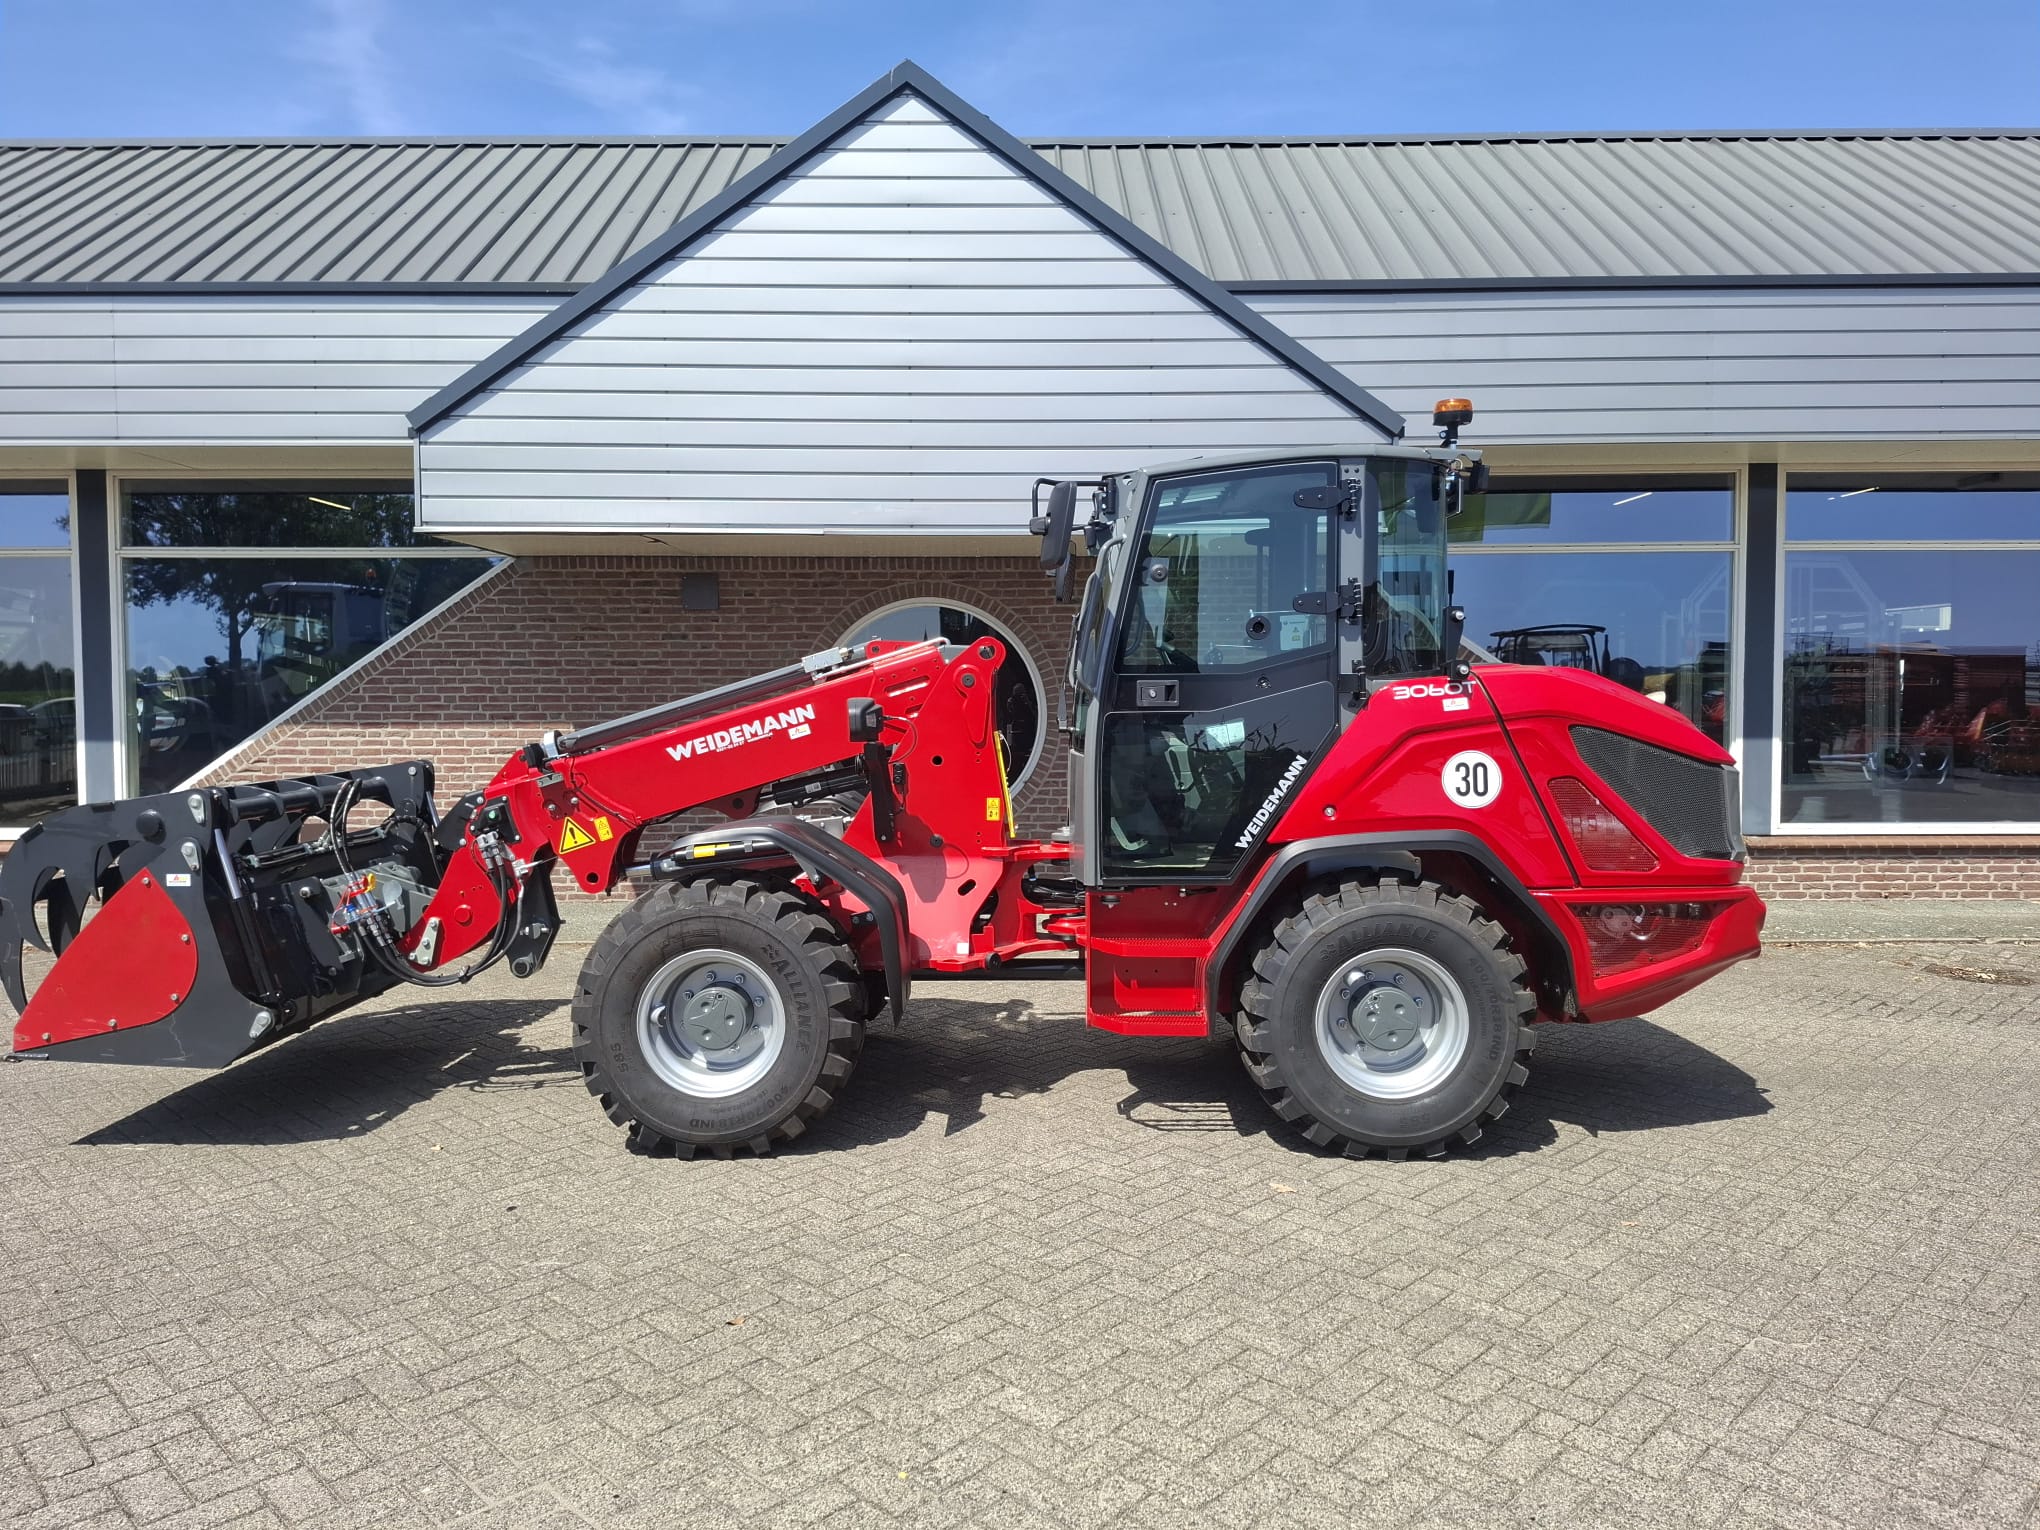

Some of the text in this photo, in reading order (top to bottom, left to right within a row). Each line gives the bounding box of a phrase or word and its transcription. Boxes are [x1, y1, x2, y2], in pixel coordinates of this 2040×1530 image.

[665, 703, 816, 761] WEIDEMANN
[1234, 754, 1308, 848] WEIDEMANN
[1455, 762, 1489, 797] 30
[1337, 921, 1440, 953] ALLIANCE
[770, 958, 811, 1056] ALLIANCE
